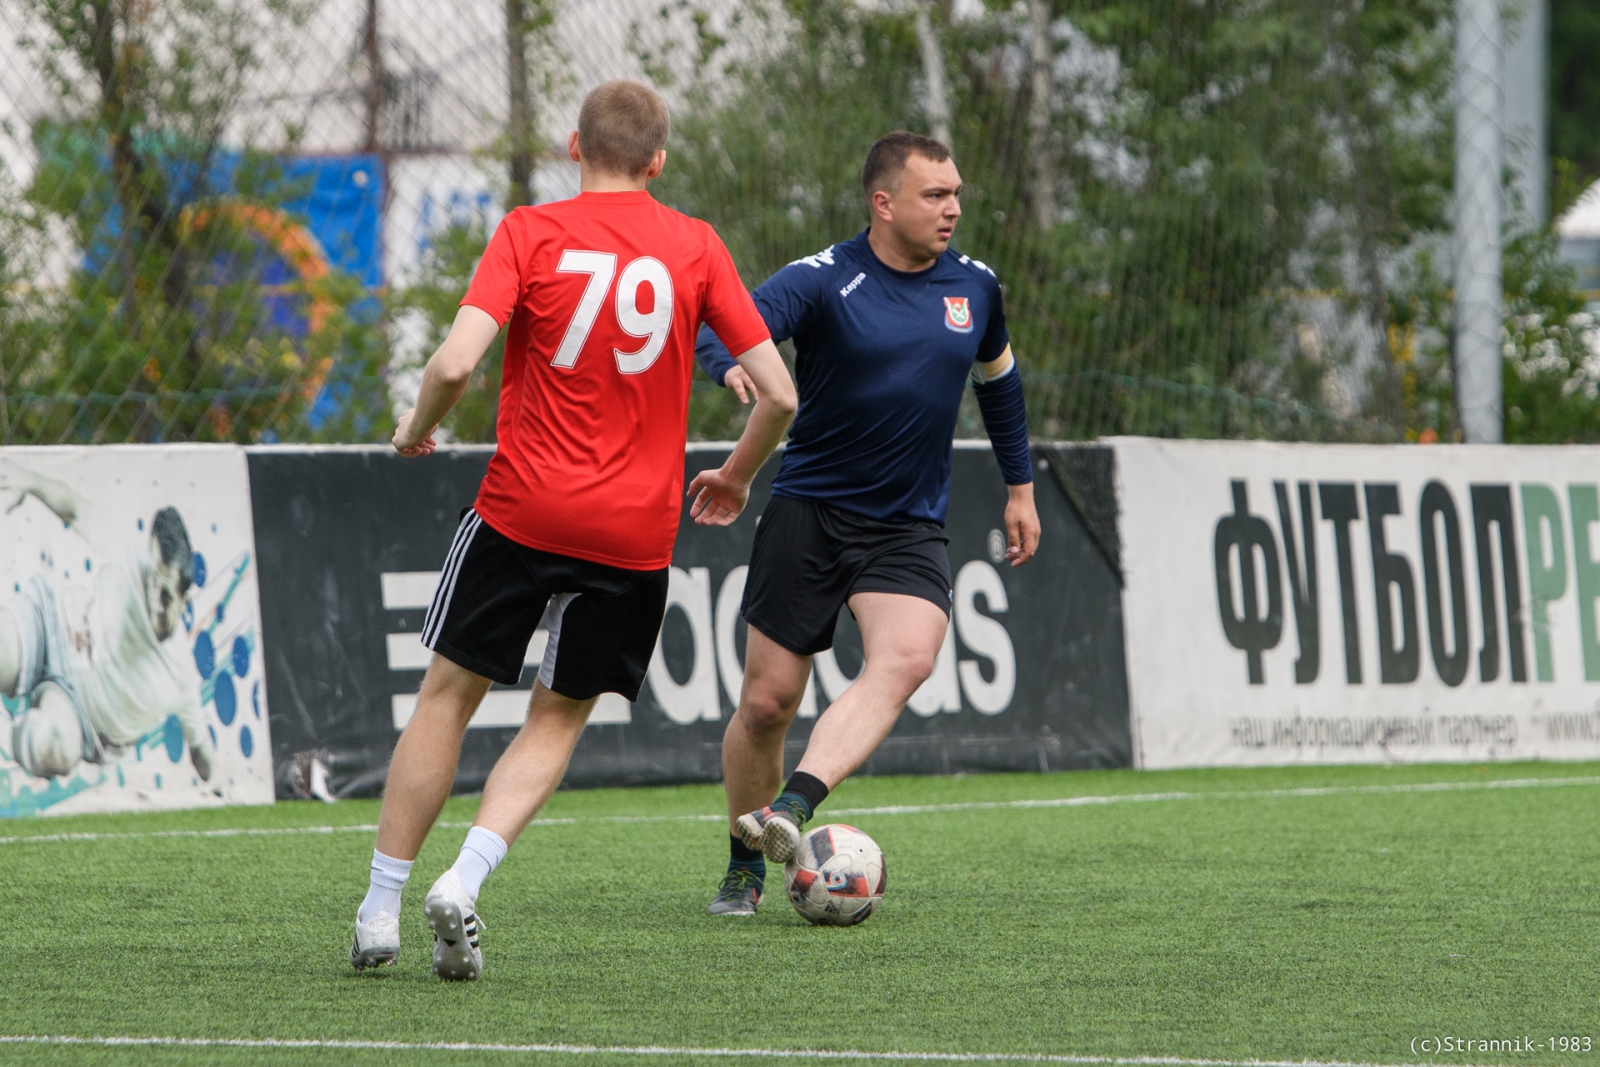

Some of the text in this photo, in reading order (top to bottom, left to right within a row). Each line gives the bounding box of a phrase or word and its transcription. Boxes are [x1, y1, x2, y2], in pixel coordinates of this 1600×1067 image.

[839, 271, 867, 298] Kappa
[550, 249, 674, 375] 79
[1437, 713, 1518, 754] партнер
